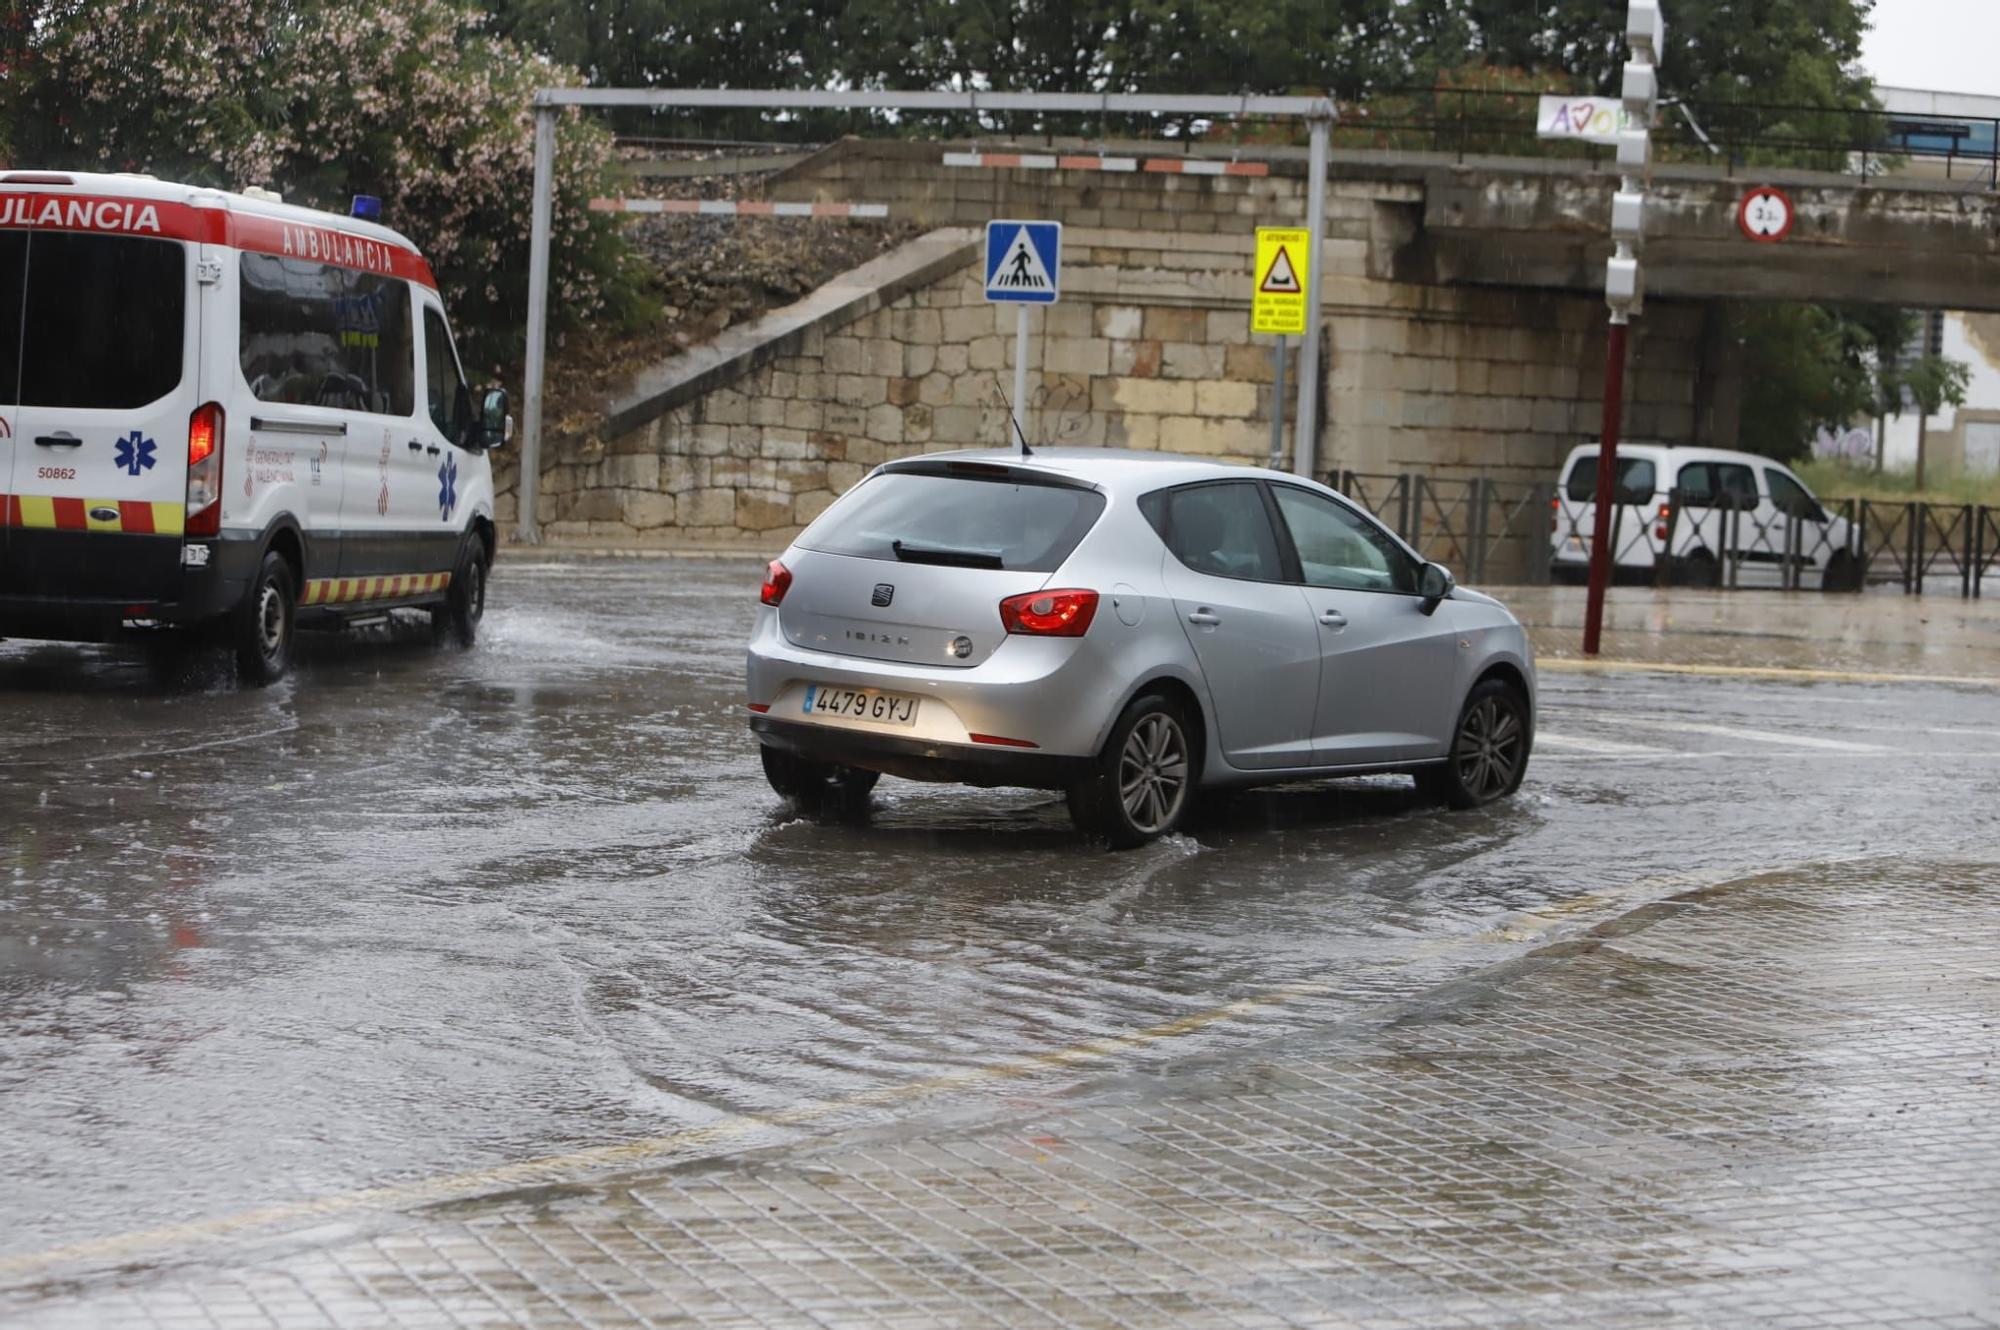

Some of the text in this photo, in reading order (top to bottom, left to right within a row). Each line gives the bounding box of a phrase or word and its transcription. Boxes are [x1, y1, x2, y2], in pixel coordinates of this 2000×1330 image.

[283, 225, 393, 272] AMBULANCIA
[310, 457, 321, 472] 112
[38, 467, 76, 480] 50862
[845, 630, 910, 645] IBIZA
[816, 689, 914, 721] 4479 GYJ
